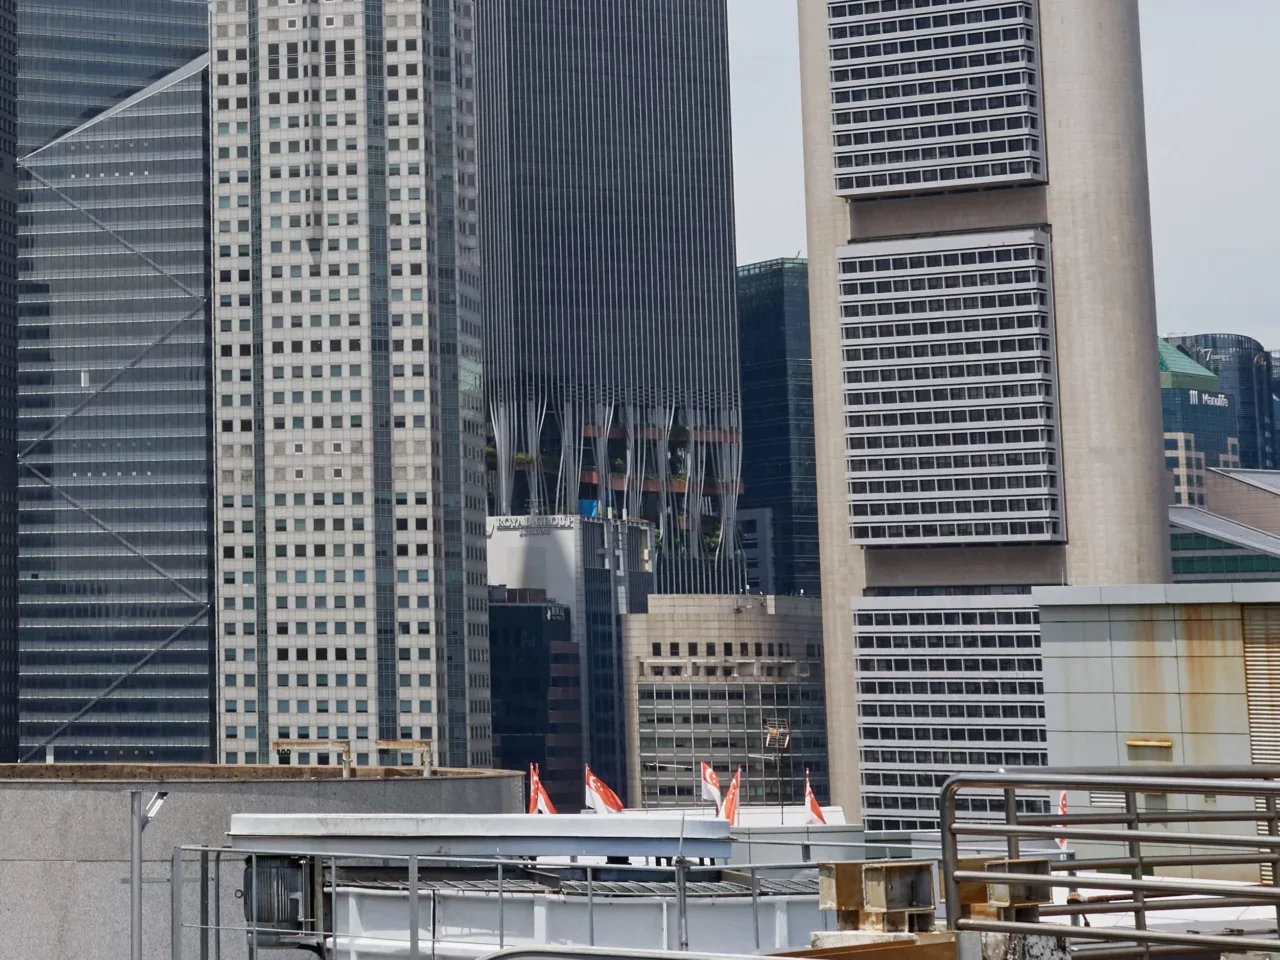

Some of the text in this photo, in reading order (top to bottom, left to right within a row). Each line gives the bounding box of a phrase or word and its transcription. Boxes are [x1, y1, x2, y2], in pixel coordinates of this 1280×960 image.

[1202, 393, 1228, 407] Manulife
[497, 516, 574, 528] ROYAL GROUP
